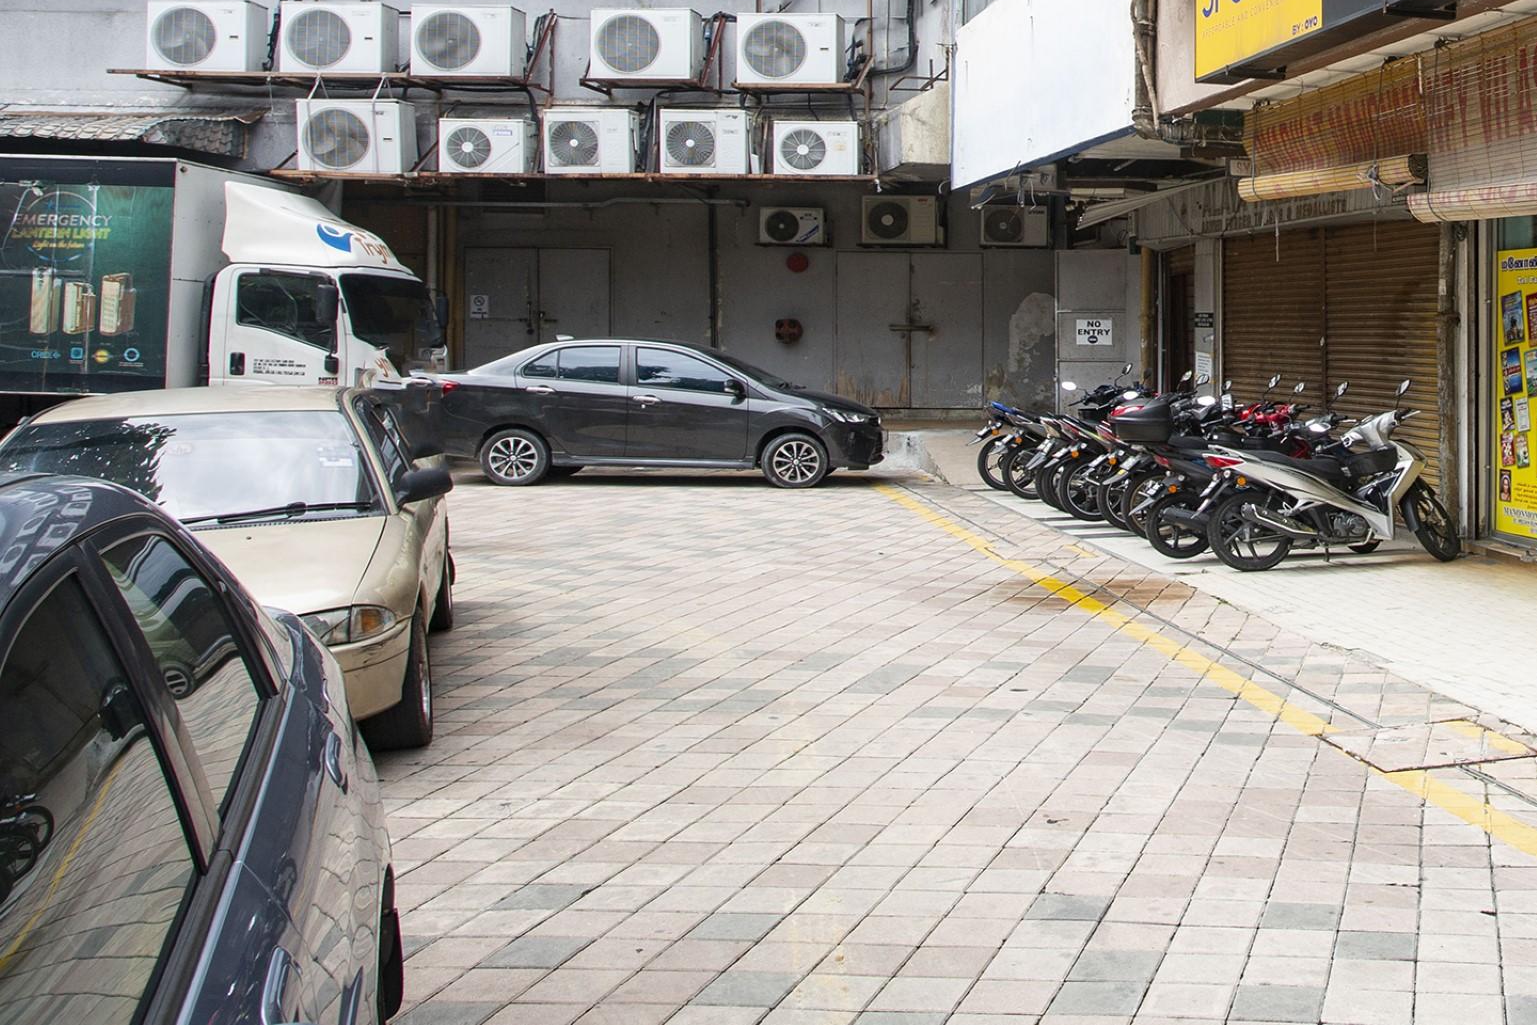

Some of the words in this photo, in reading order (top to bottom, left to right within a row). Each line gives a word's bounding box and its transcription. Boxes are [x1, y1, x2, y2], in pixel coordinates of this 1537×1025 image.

[14, 214, 112, 227] EMERGENCY
[1087, 320, 1101, 328] NO
[1077, 328, 1111, 336] ENTRY
